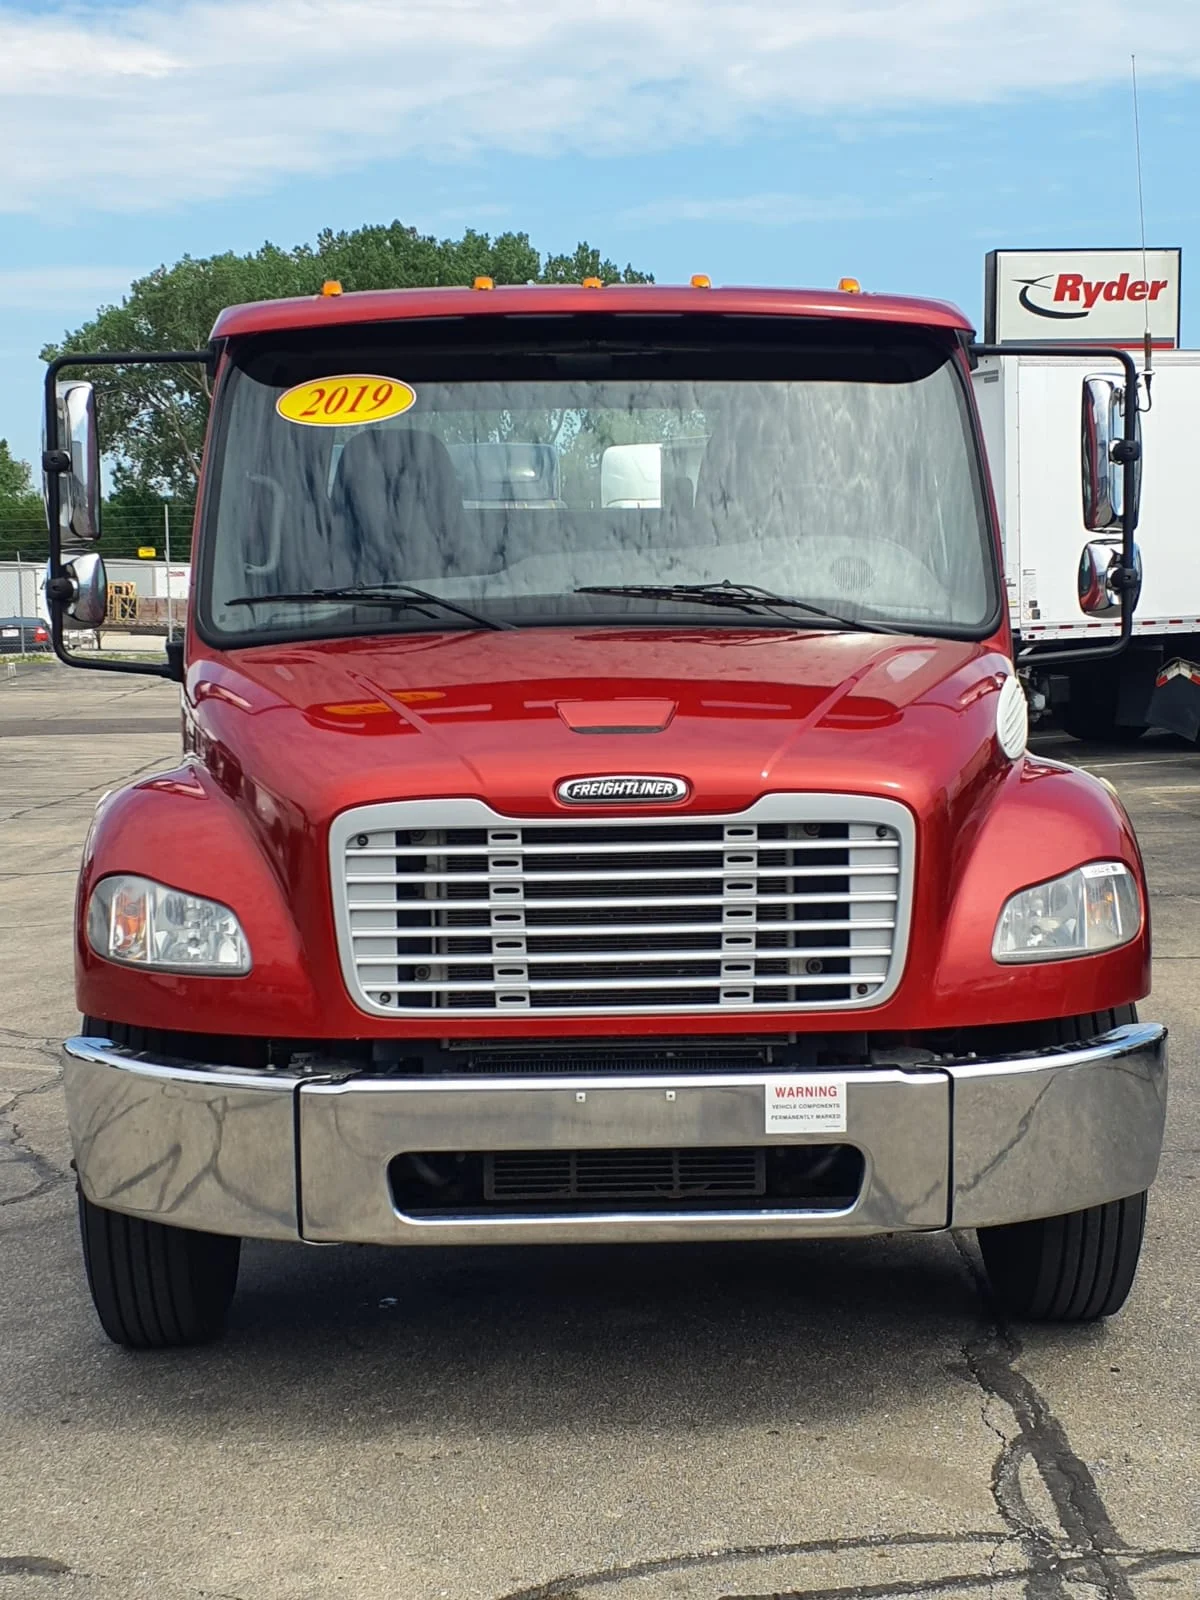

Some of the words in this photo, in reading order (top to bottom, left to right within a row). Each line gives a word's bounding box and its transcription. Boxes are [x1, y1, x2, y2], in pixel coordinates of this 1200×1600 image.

[1053, 273, 1168, 308] Ryder
[300, 383, 393, 416] 2019
[572, 782, 674, 796] FREIGHTLINER
[775, 1086, 837, 1098] WARNING
